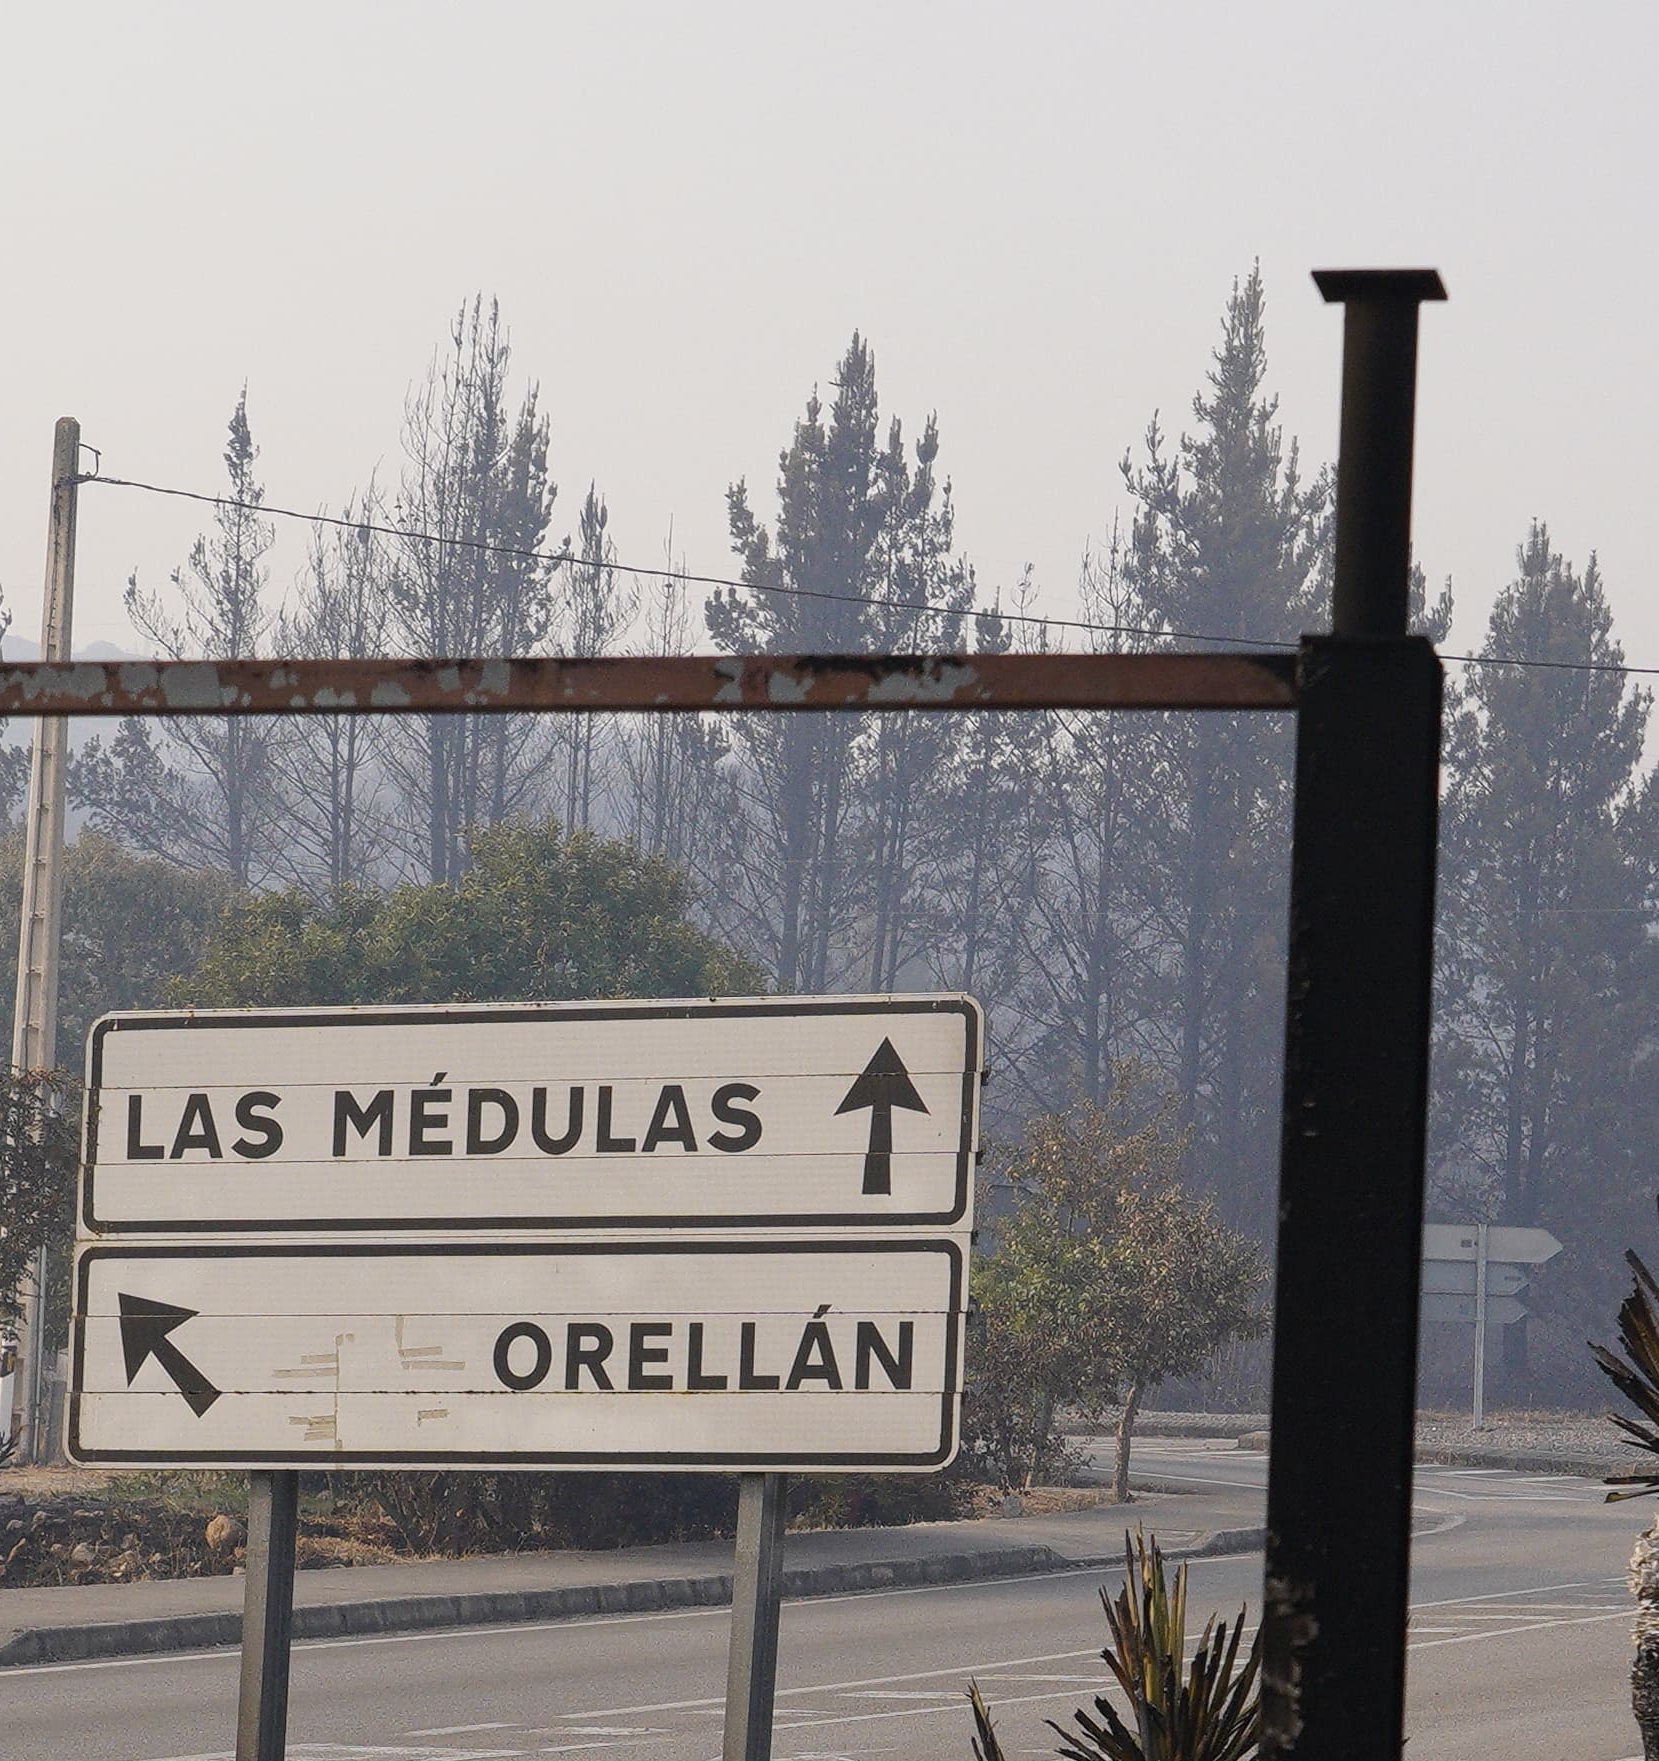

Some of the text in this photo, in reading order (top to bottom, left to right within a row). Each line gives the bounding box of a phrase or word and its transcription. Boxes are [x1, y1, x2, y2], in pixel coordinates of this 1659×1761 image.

[126, 1071, 763, 1161] LAS MÉDULAS
[493, 1304, 915, 1392] ORELLÁN
